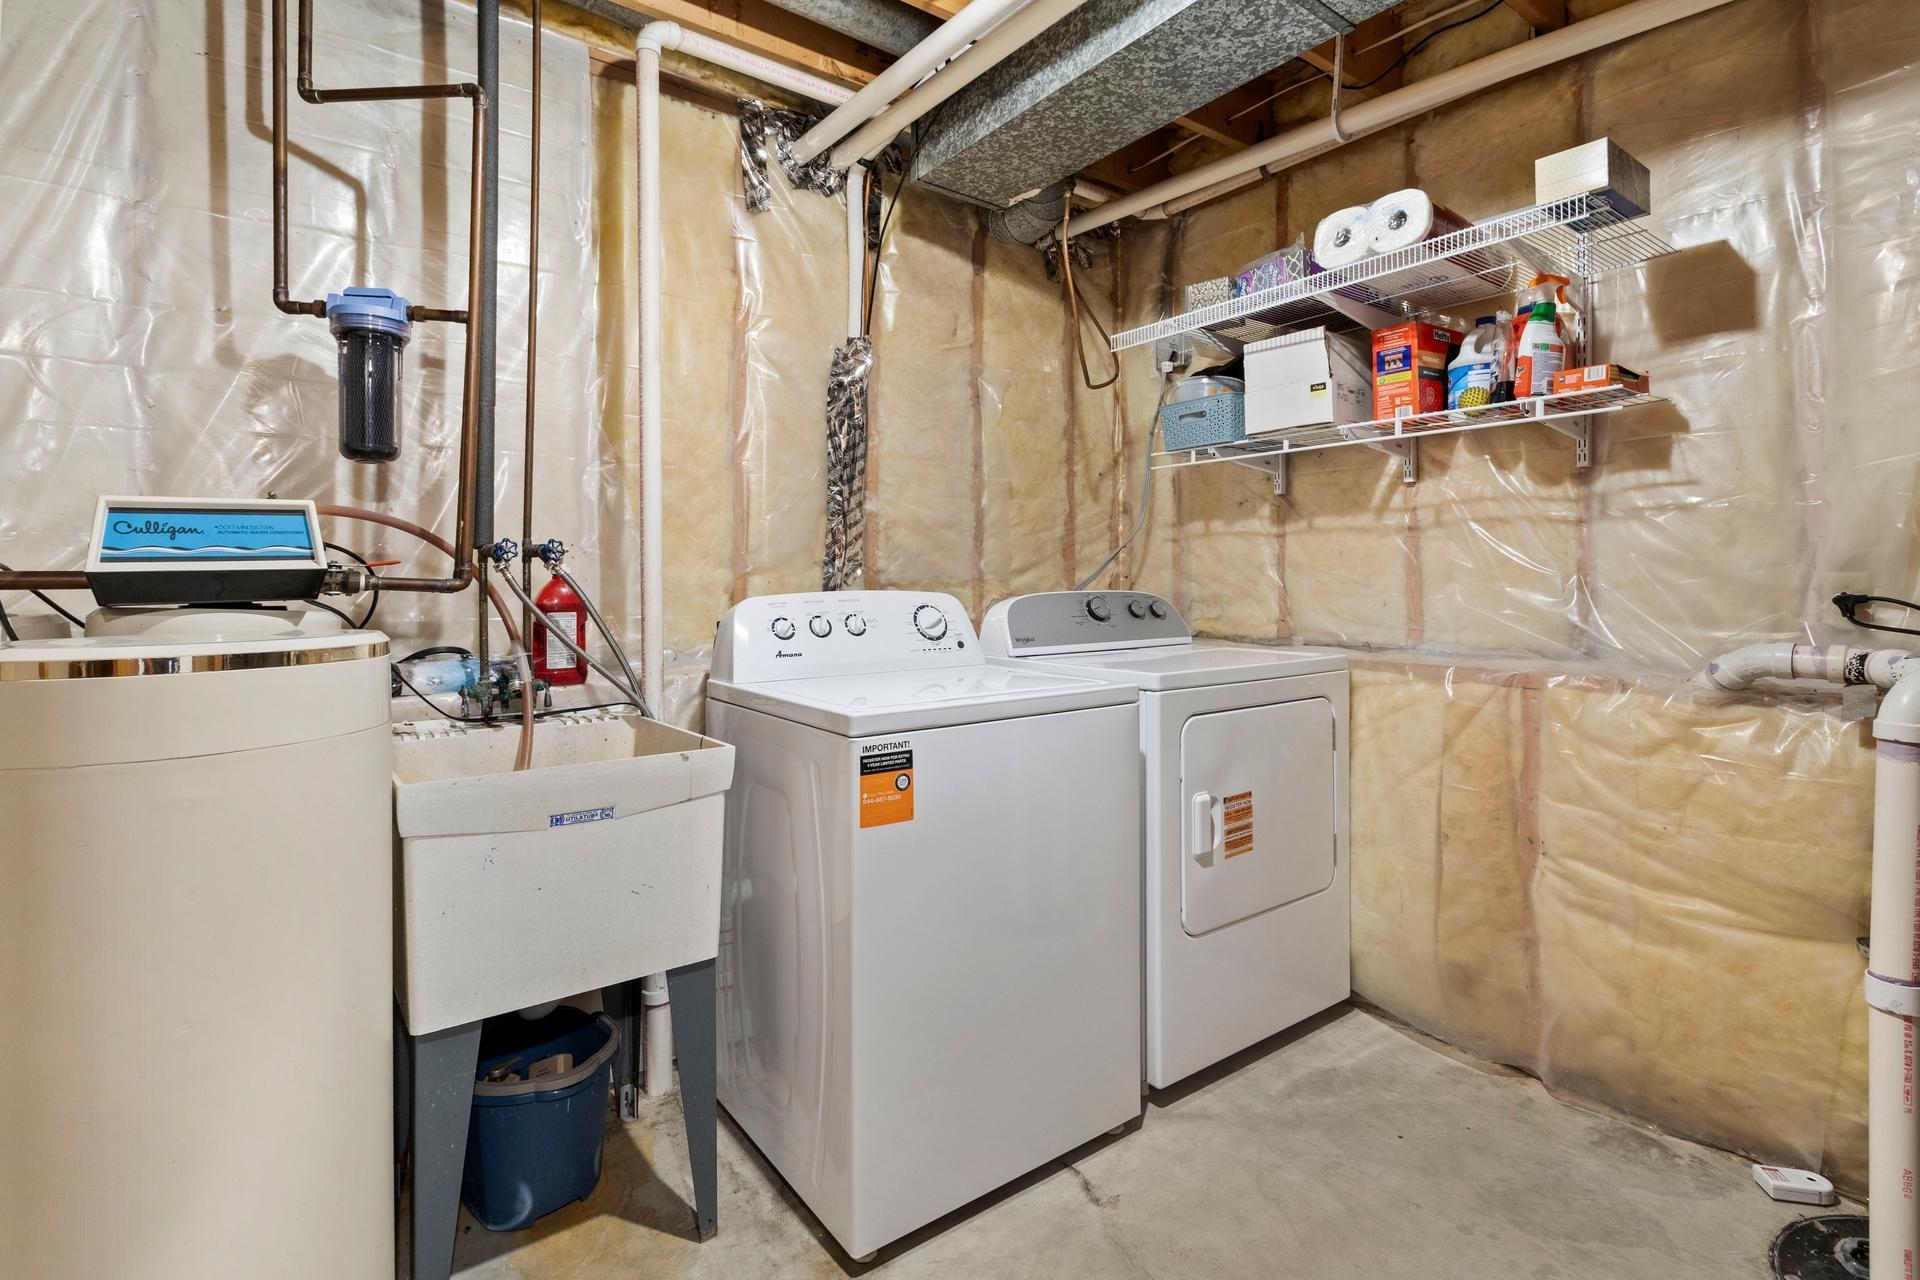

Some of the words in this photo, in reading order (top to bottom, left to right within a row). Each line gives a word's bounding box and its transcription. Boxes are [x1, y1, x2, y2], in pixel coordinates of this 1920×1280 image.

[1434, 330, 1450, 341] Hefty
[1422, 355, 1440, 364] STRONG
[113, 520, 203, 541] Culligan
[775, 650, 803, 659] Amana
[862, 740, 911, 754] IMPORTANT!
